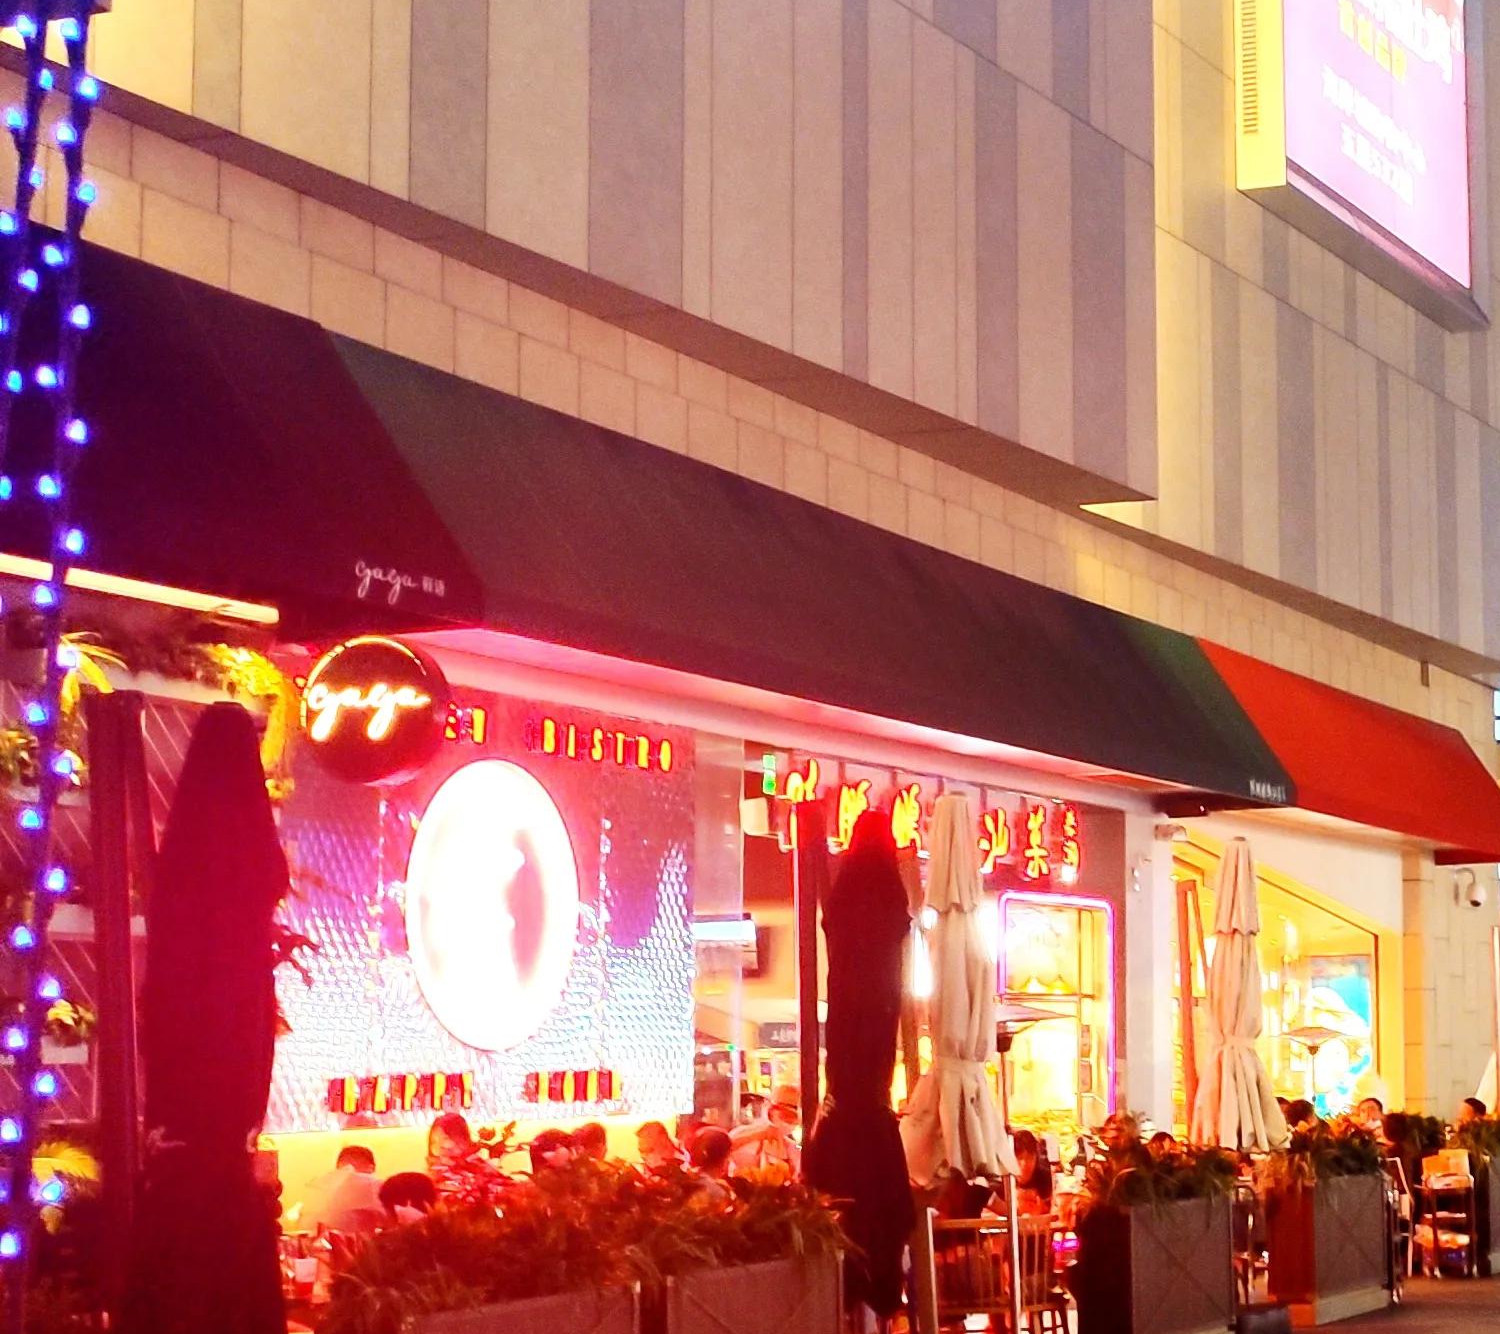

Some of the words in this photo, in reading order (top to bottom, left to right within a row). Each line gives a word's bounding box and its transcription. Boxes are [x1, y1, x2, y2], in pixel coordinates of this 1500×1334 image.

[354, 560, 418, 606] gaga
[306, 681, 432, 742] gaga
[542, 717, 671, 772] BISTRO
